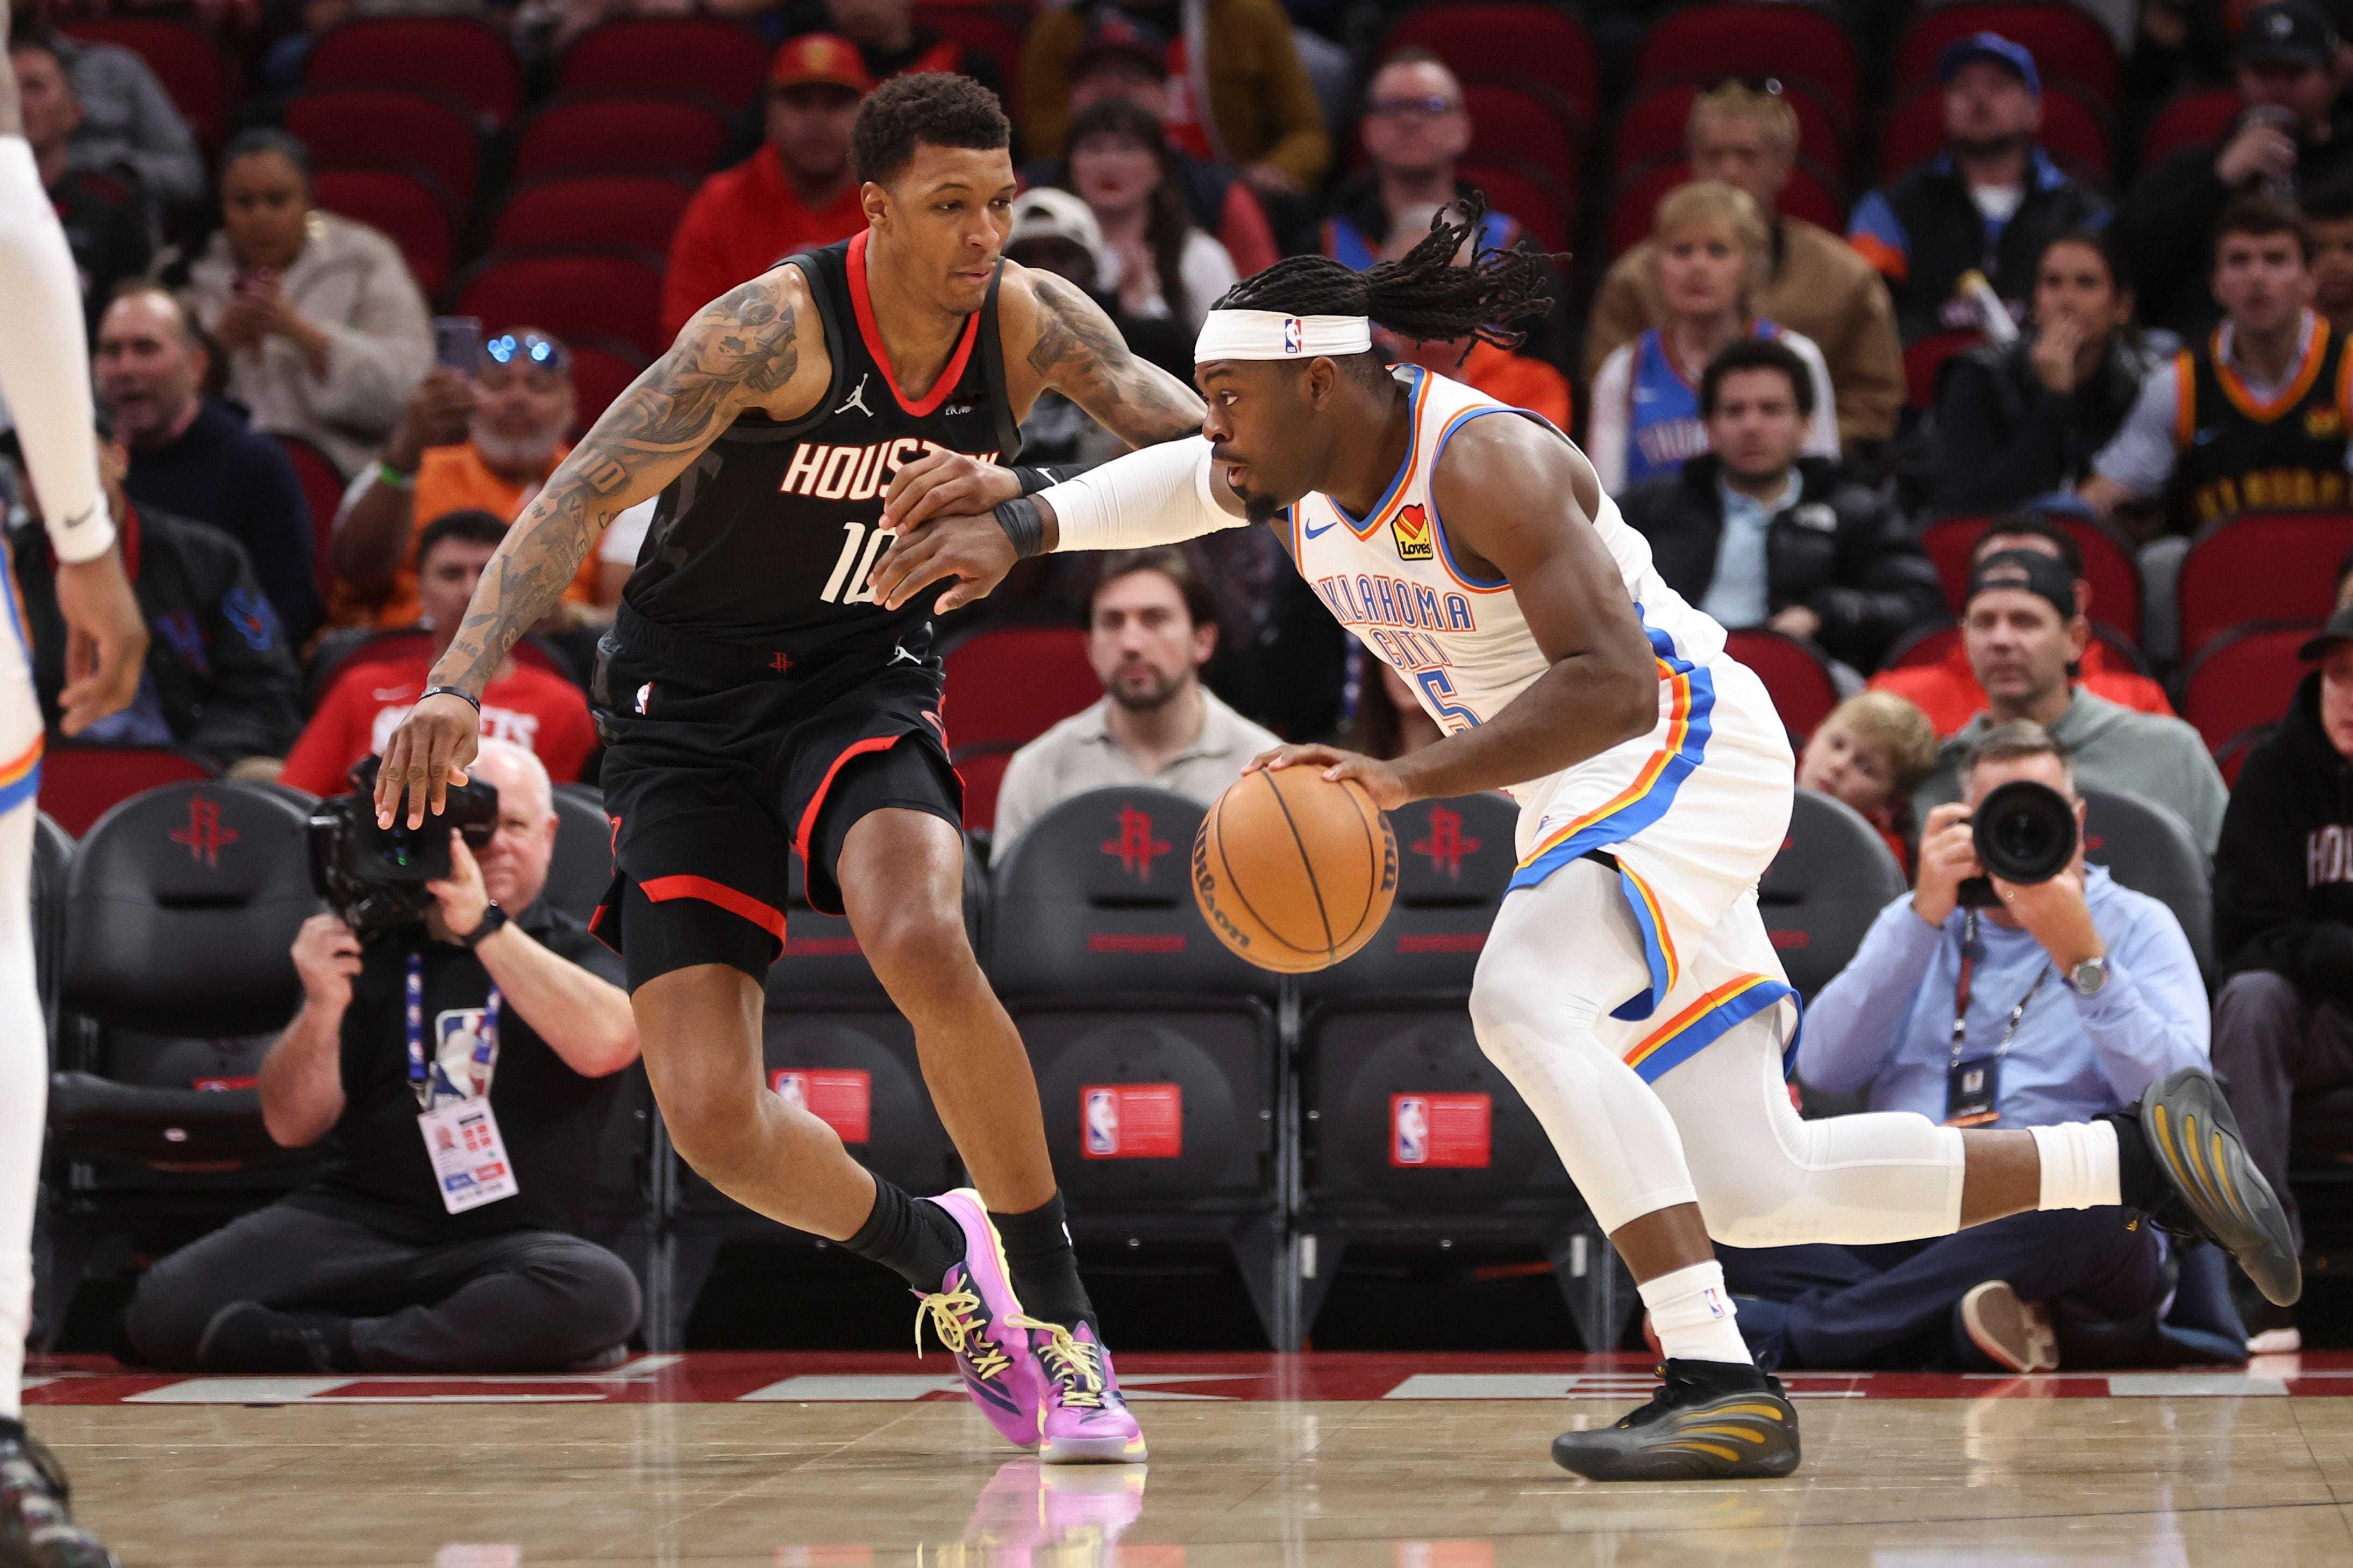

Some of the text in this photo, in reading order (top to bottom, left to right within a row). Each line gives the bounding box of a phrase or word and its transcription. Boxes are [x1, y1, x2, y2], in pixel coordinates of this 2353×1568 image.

[779, 436, 1000, 500] HOUS
[1400, 538, 1431, 554] Love's
[1369, 628, 1453, 670] CITY
[1413, 664, 1484, 737] 5
